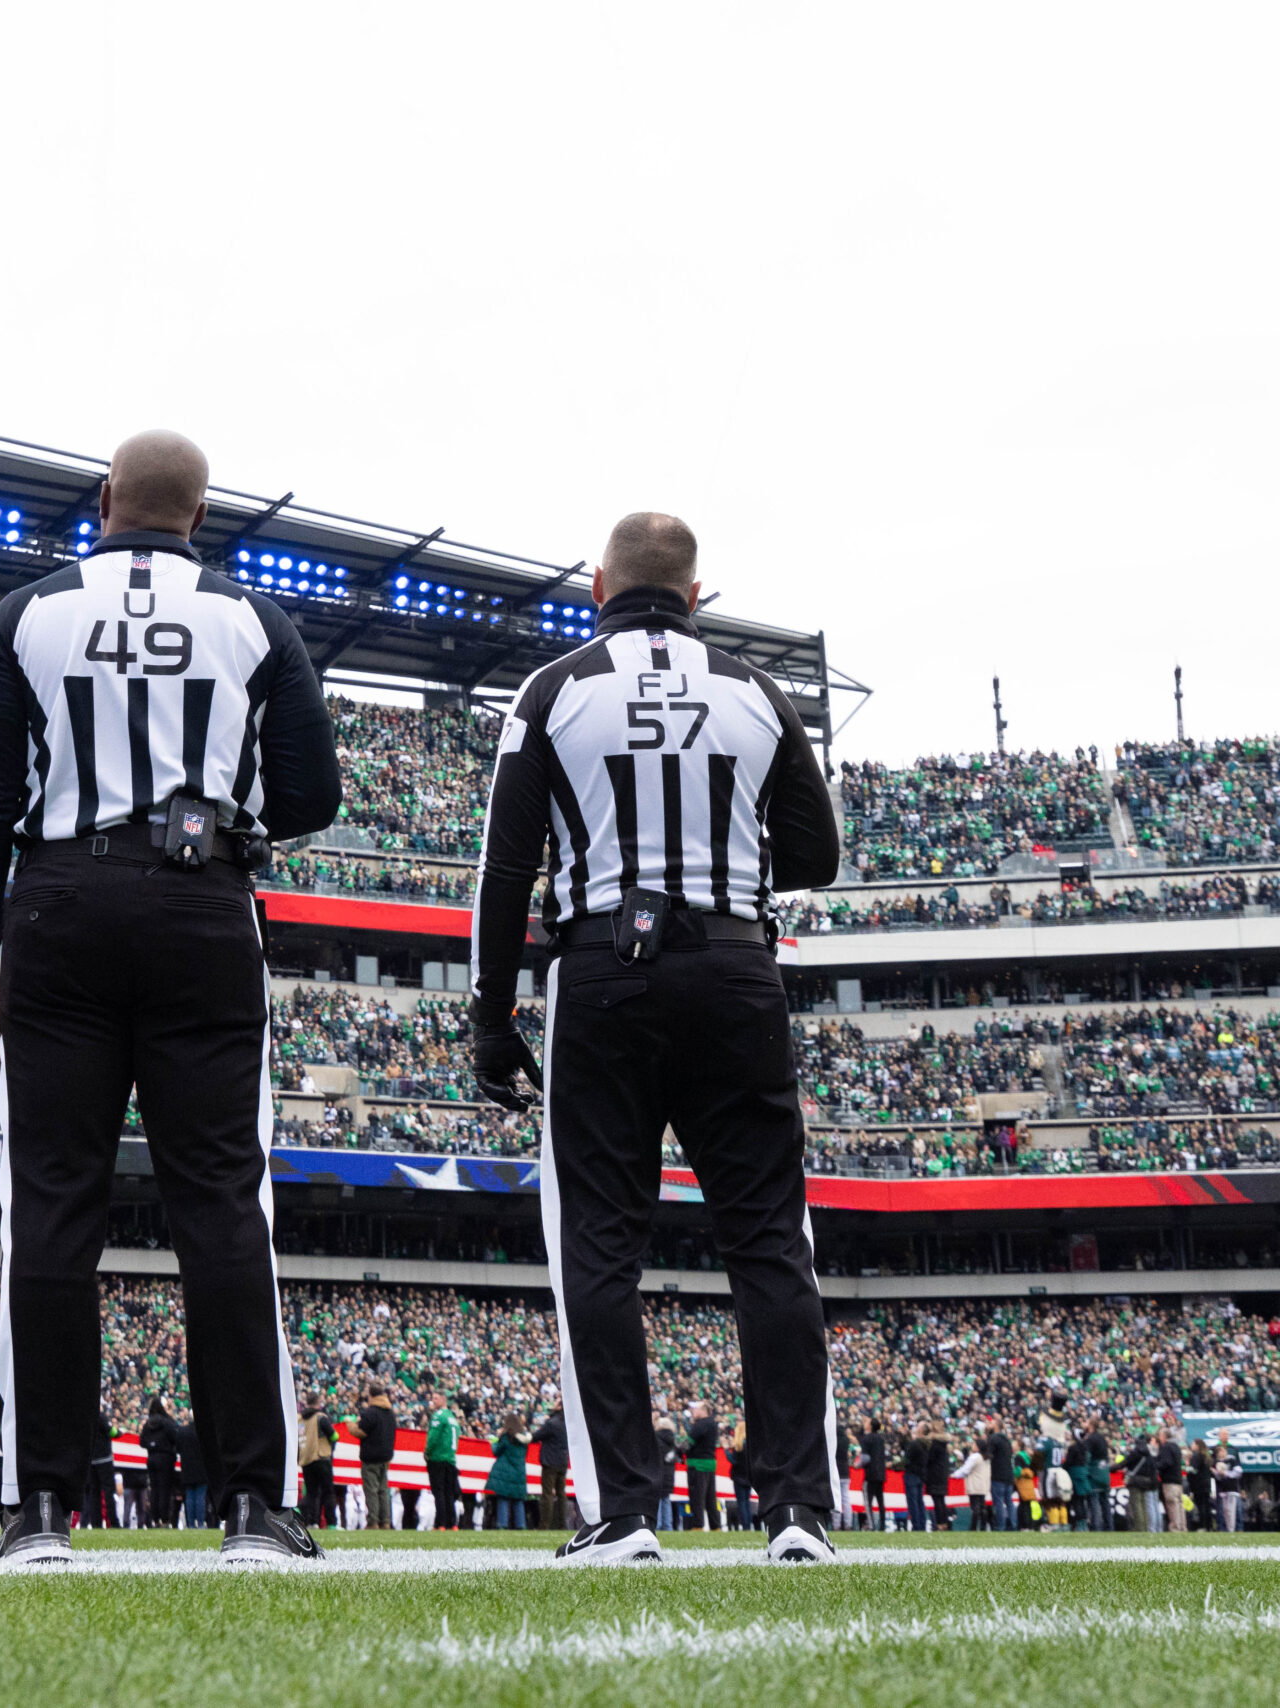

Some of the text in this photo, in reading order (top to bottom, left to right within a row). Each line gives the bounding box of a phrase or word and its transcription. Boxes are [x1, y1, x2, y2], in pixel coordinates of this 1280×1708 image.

[134, 561, 151, 569] NFL
[124, 592, 155, 618] U
[85, 620, 193, 675] 49
[637, 672, 688, 697] FJ
[626, 702, 710, 750] 57
[185, 821, 200, 833] NFL
[636, 919, 650, 929] NFL
